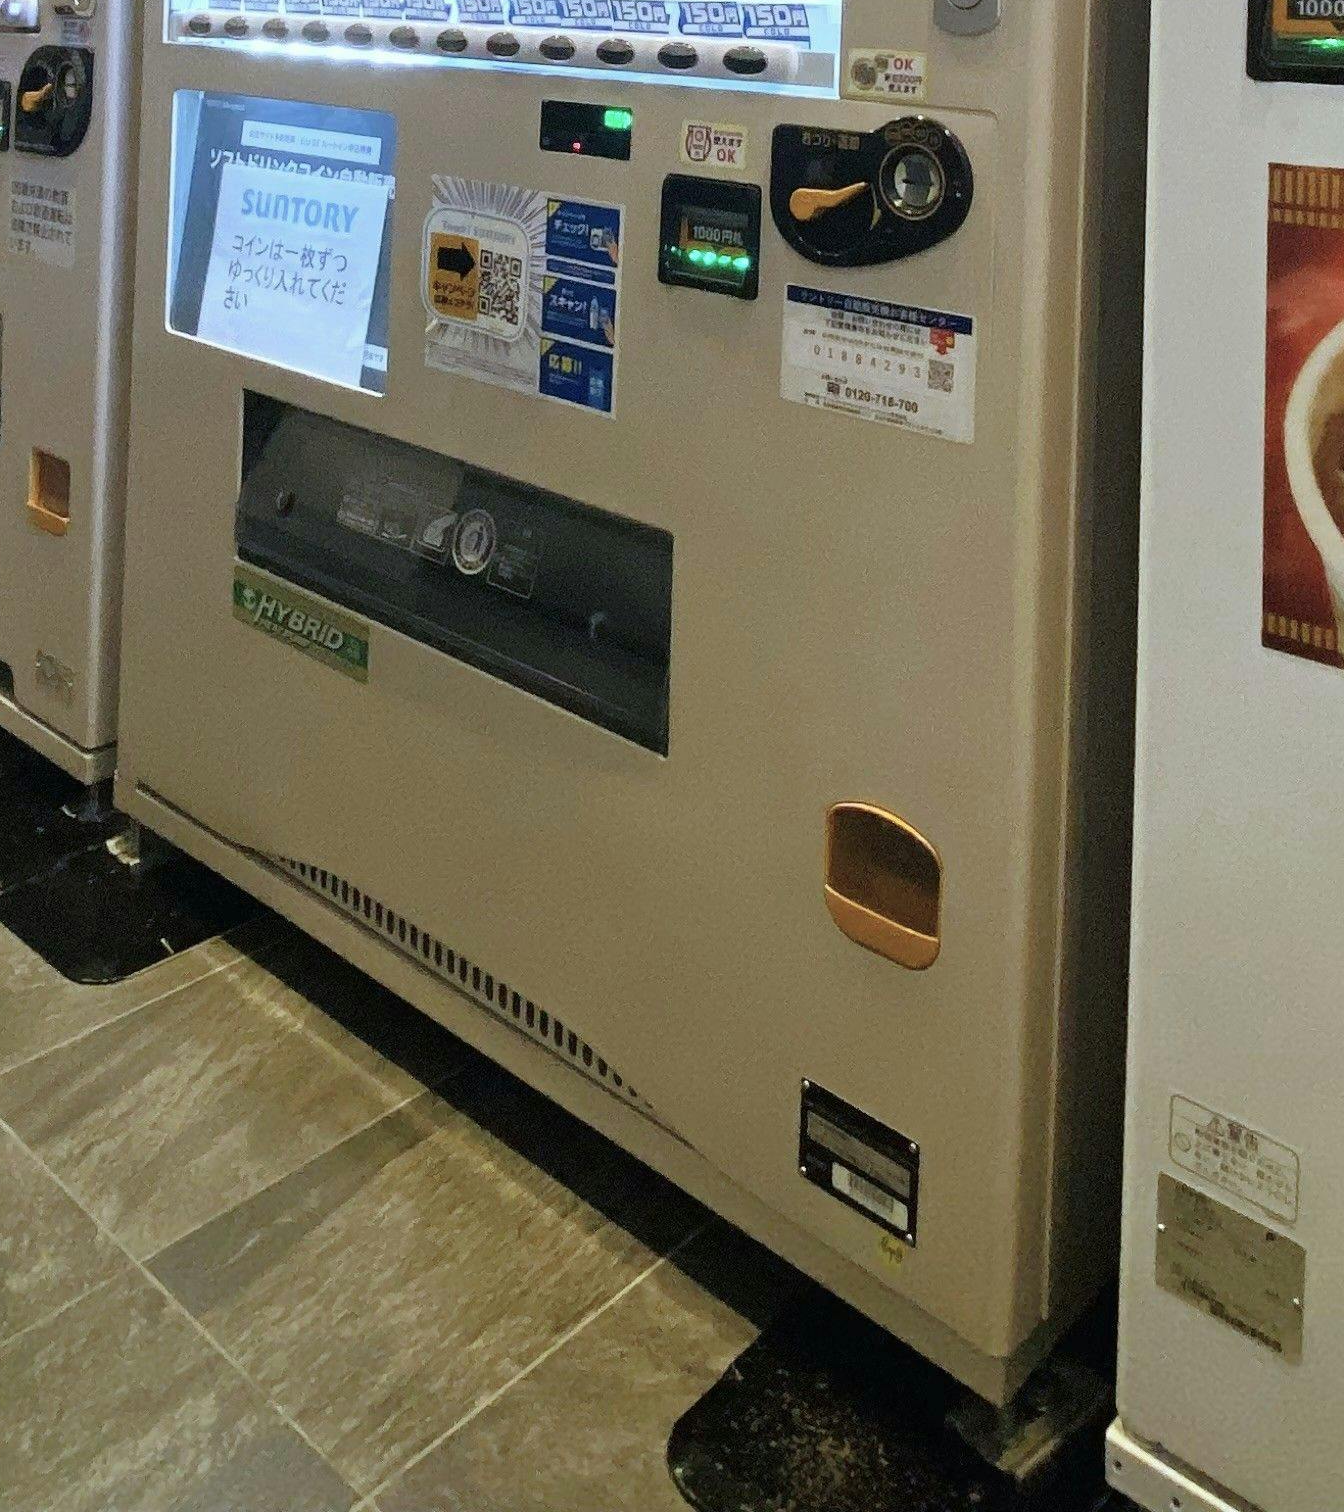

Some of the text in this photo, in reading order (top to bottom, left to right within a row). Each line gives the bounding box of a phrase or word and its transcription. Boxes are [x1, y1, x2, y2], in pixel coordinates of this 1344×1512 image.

[614, 0, 667, 22] 150円
[683, 2, 740, 24] 150円
[746, 3, 808, 27] 150円
[716, 148, 737, 164] OK
[241, 186, 361, 234] SUNTORY
[231, 234, 349, 274] コインは一枚ずつ
[227, 259, 348, 307] ゆっくり入れてくだ
[223, 288, 249, 312] さい
[260, 593, 345, 651] HYBRID
